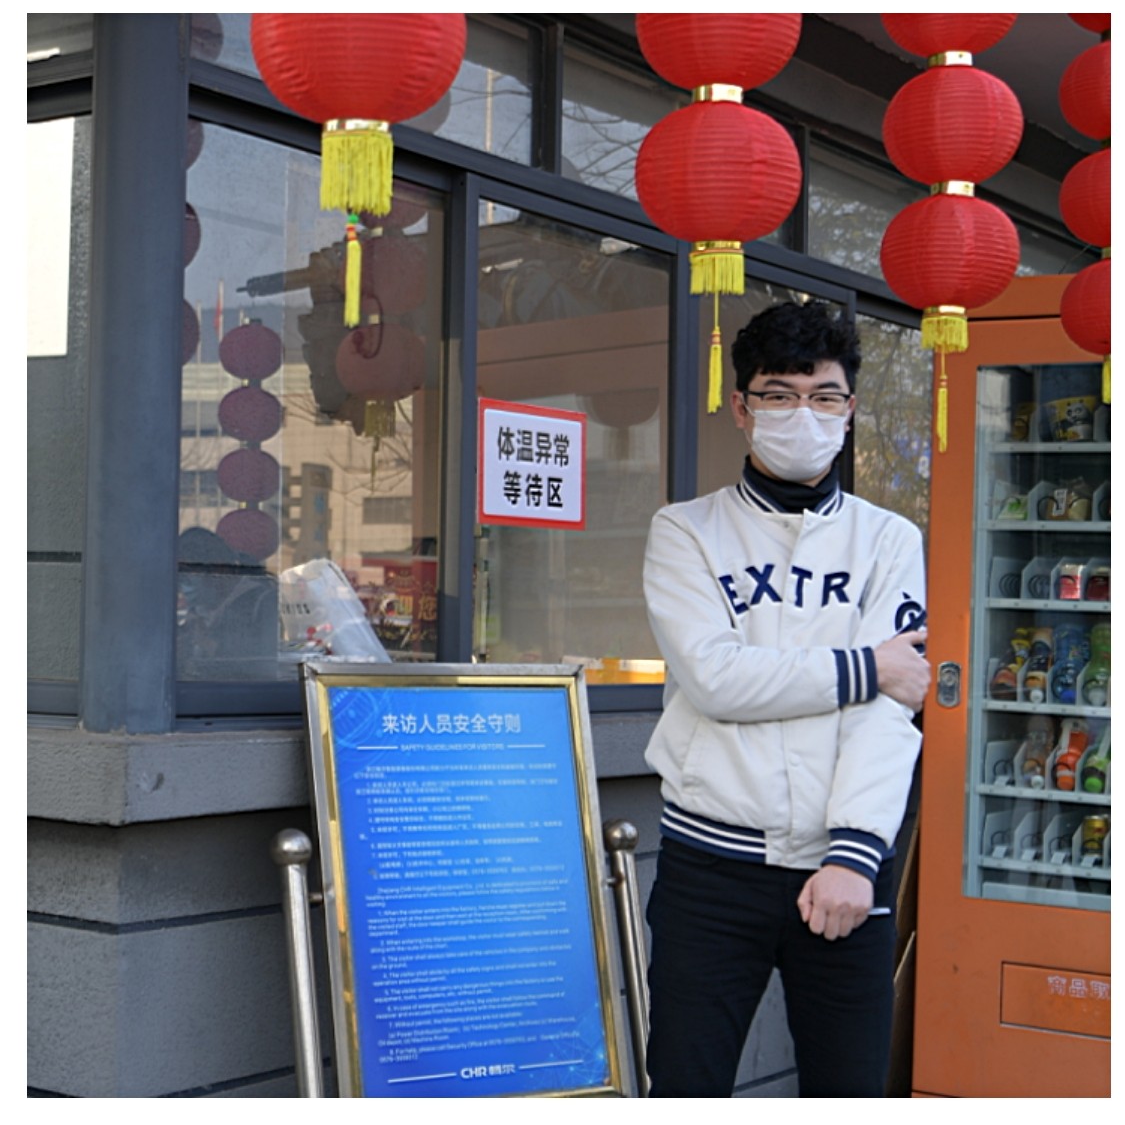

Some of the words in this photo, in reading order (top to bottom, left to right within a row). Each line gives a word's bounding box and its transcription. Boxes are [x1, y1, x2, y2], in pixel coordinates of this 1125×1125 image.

[498, 426, 569, 467] 体温异常
[504, 470, 563, 508] 等待区
[718, 564, 866, 615] EXTR
[382, 713, 521, 734] 来访人员安全守则
[461, 1066, 487, 1078] CHR
